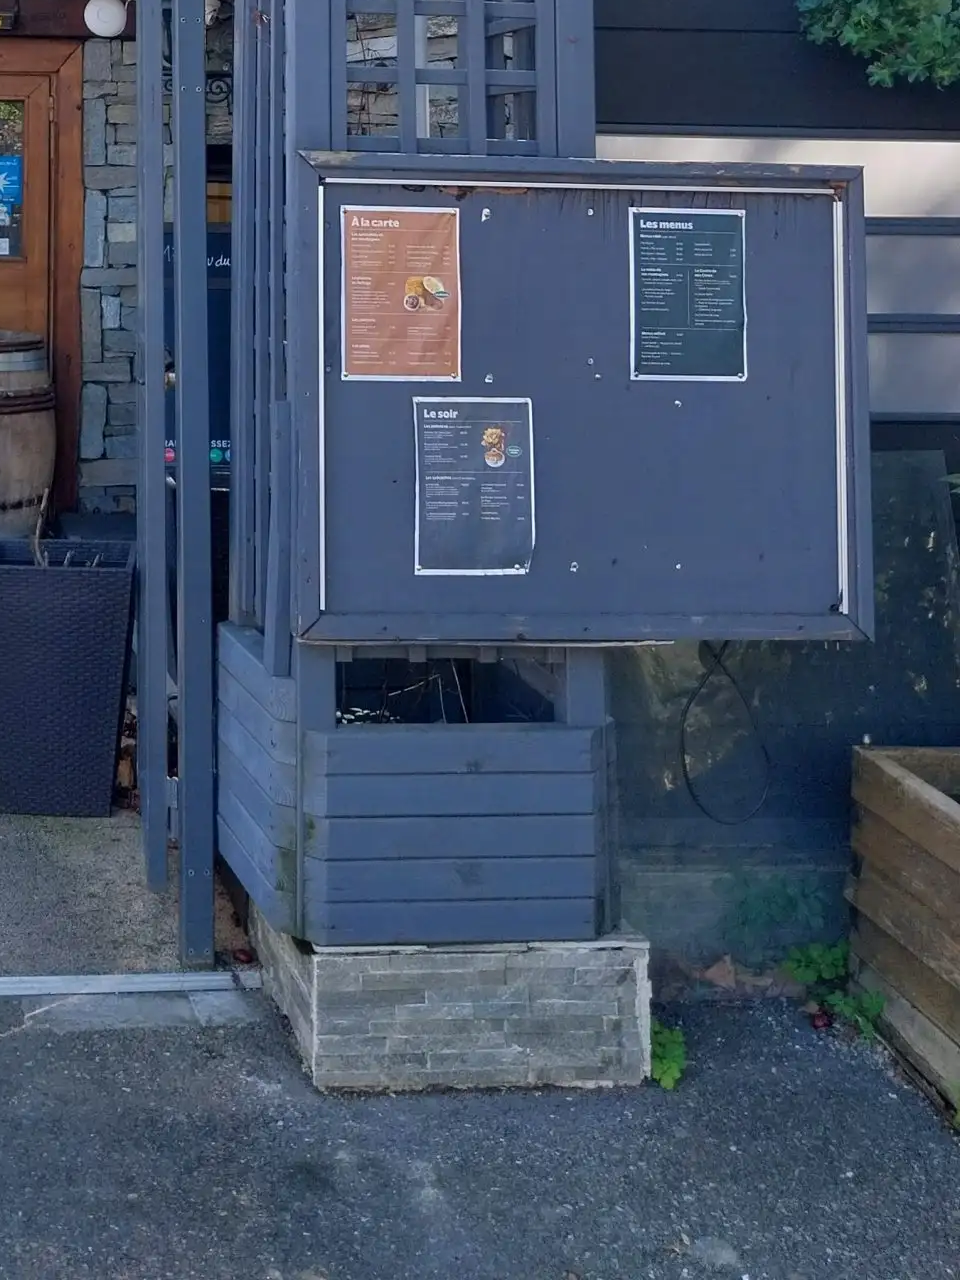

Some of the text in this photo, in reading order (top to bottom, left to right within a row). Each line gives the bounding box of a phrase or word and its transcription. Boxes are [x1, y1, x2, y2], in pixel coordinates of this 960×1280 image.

[361, 217, 370, 227] la
[371, 218, 400, 228] carte
[640, 219, 693, 230] Les menus
[423, 408, 458, 419] Le soir
